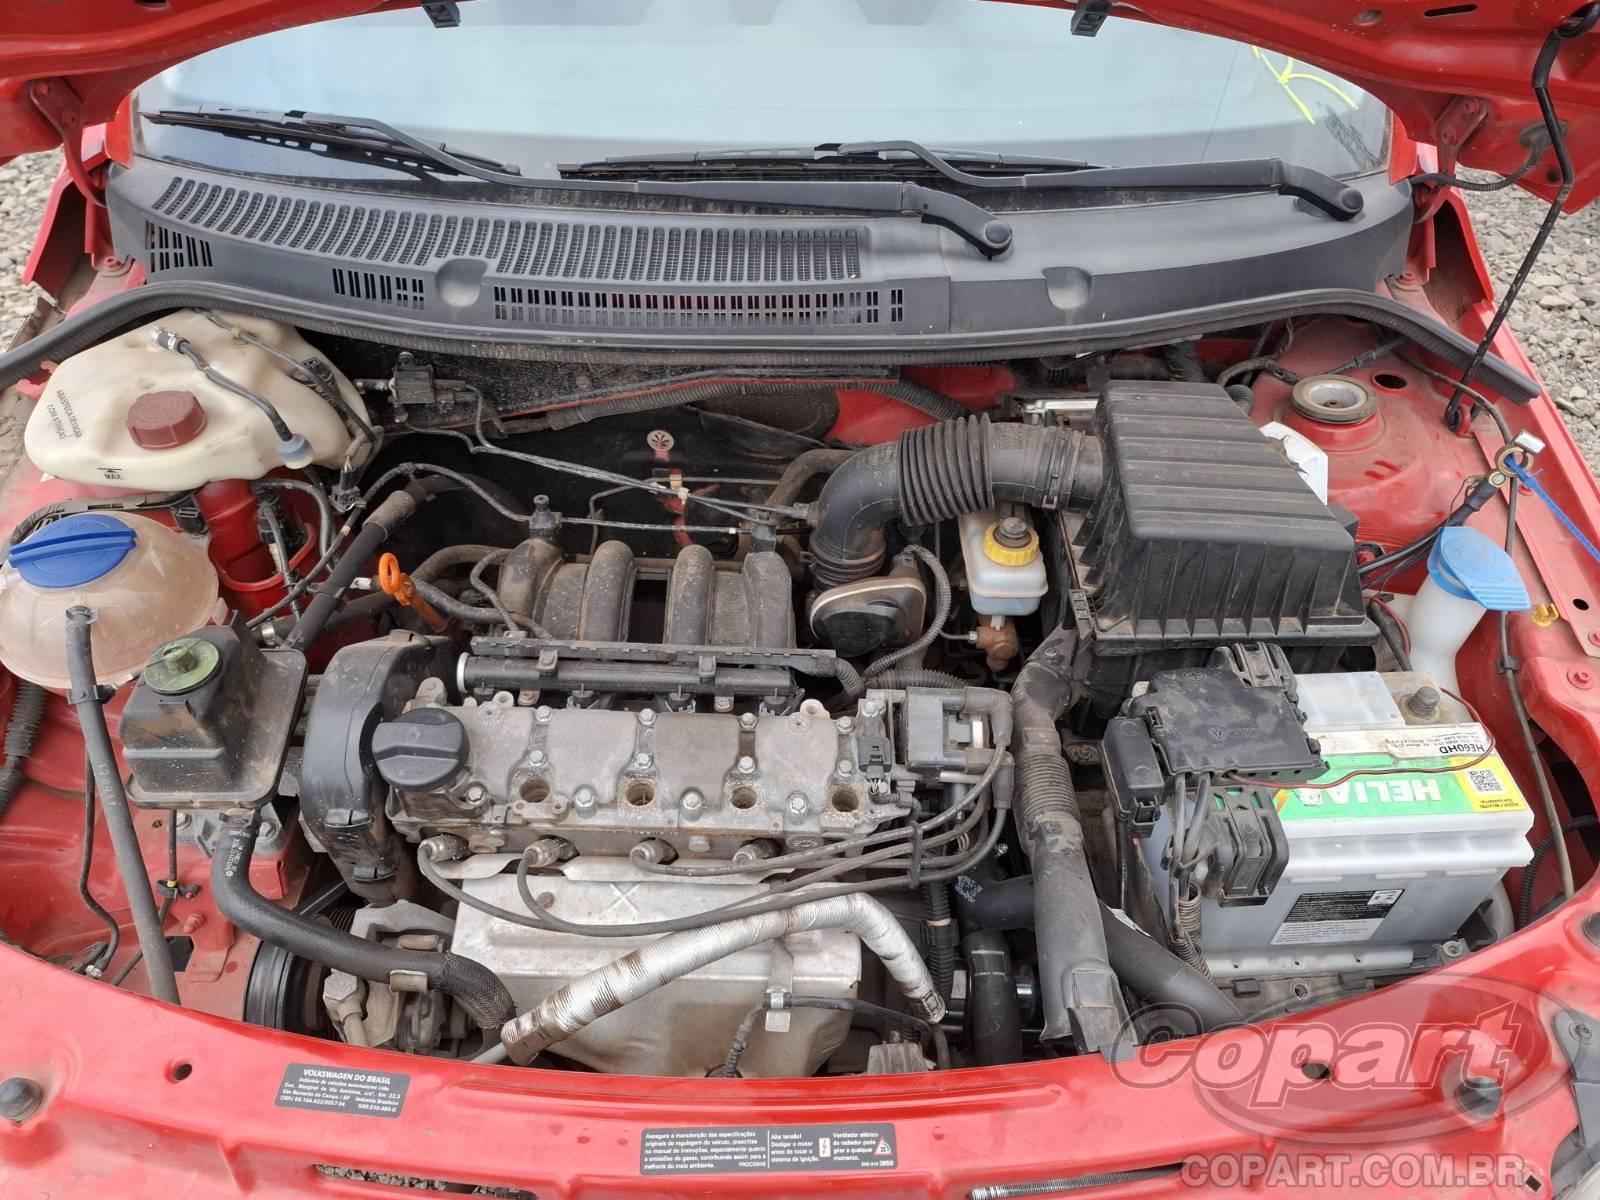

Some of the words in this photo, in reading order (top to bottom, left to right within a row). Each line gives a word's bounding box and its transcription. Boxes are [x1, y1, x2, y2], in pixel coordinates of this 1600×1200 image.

[46, 404, 58, 419] COM
[1438, 742, 1485, 754] HE60HD
[304, 1068, 352, 1081] VOLKSWAGEN
[354, 1074, 366, 1082] DO
[366, 1075, 392, 1085] BRASIL
